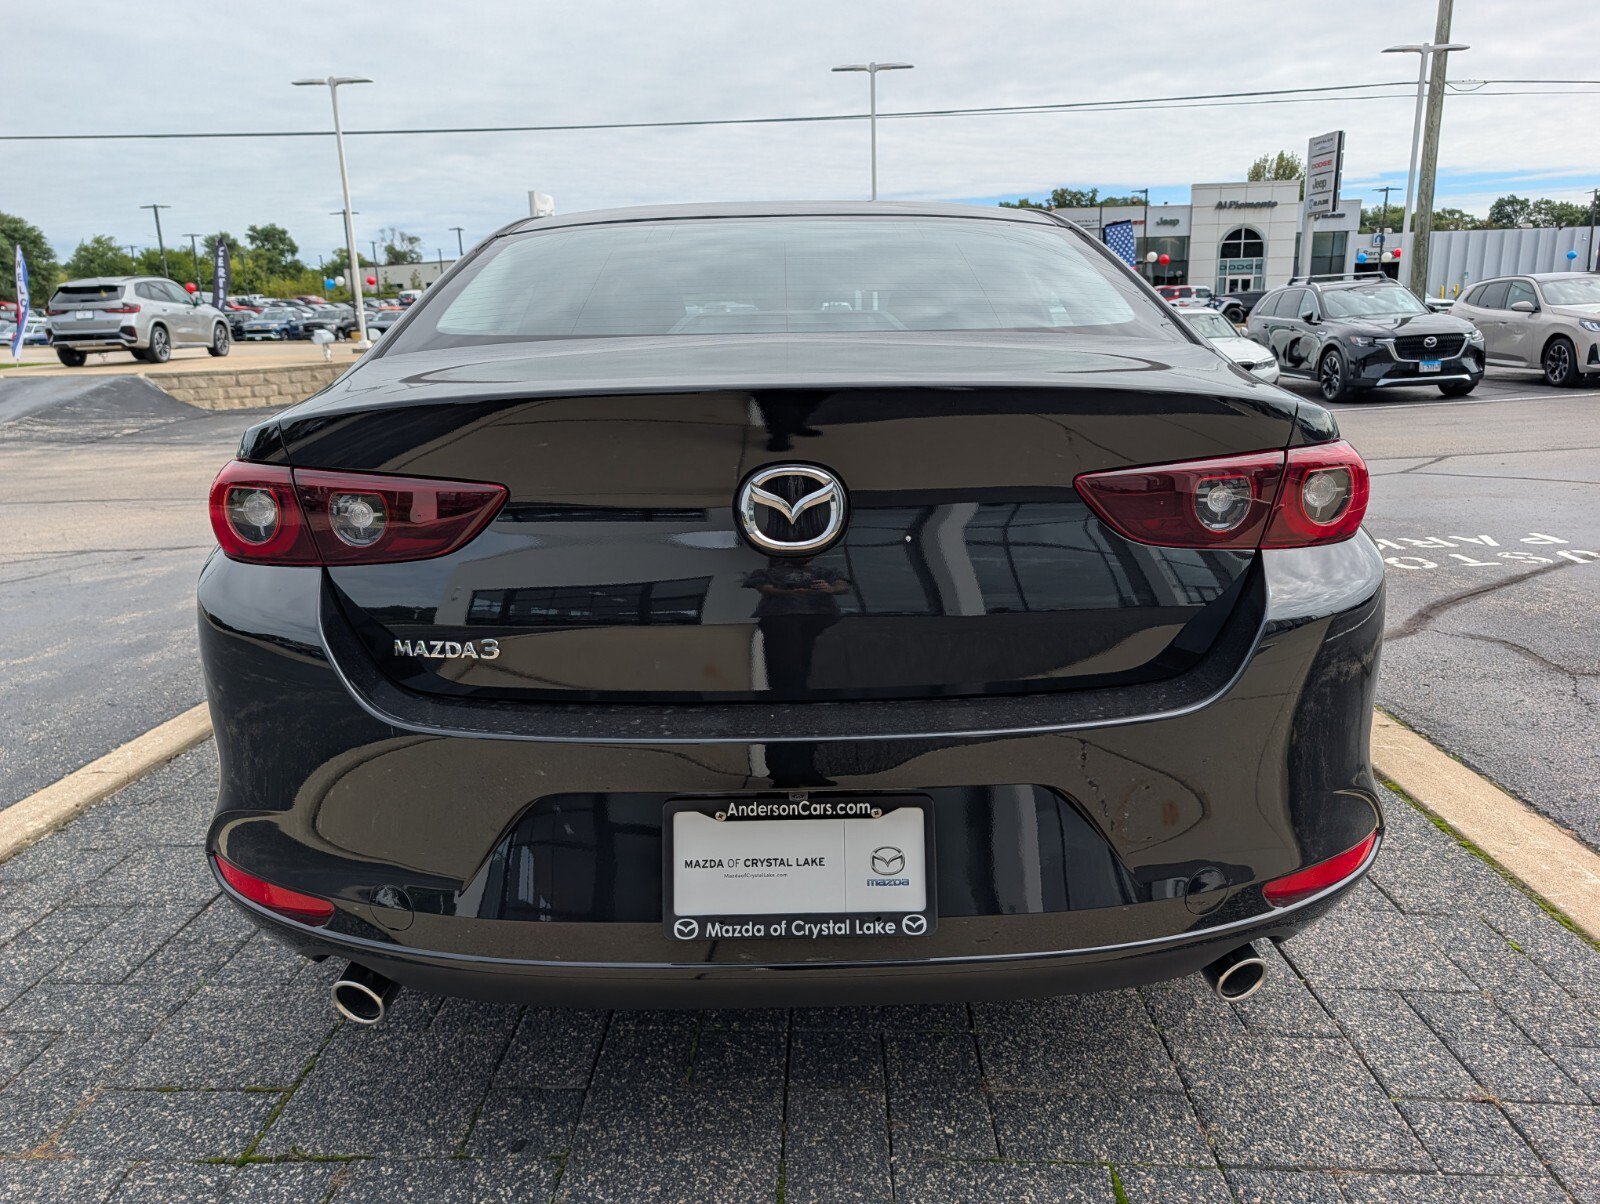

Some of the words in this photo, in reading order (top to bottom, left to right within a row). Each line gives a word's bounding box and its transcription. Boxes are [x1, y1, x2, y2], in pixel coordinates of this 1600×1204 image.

[1311, 159, 1333, 170] DODGE
[1312, 178, 1327, 190] Jeep
[1156, 217, 1180, 227] Jeep
[726, 800, 871, 818] AndersonCars.com
[684, 858, 724, 869] MAZDA
[727, 858, 741, 869] OF
[743, 857, 793, 868] CRYSTAL
[796, 856, 826, 867] LAKE
[705, 921, 765, 938] Mazda
[770, 920, 786, 936] of
[791, 919, 850, 939] Crystal
[855, 918, 896, 935] Lake
